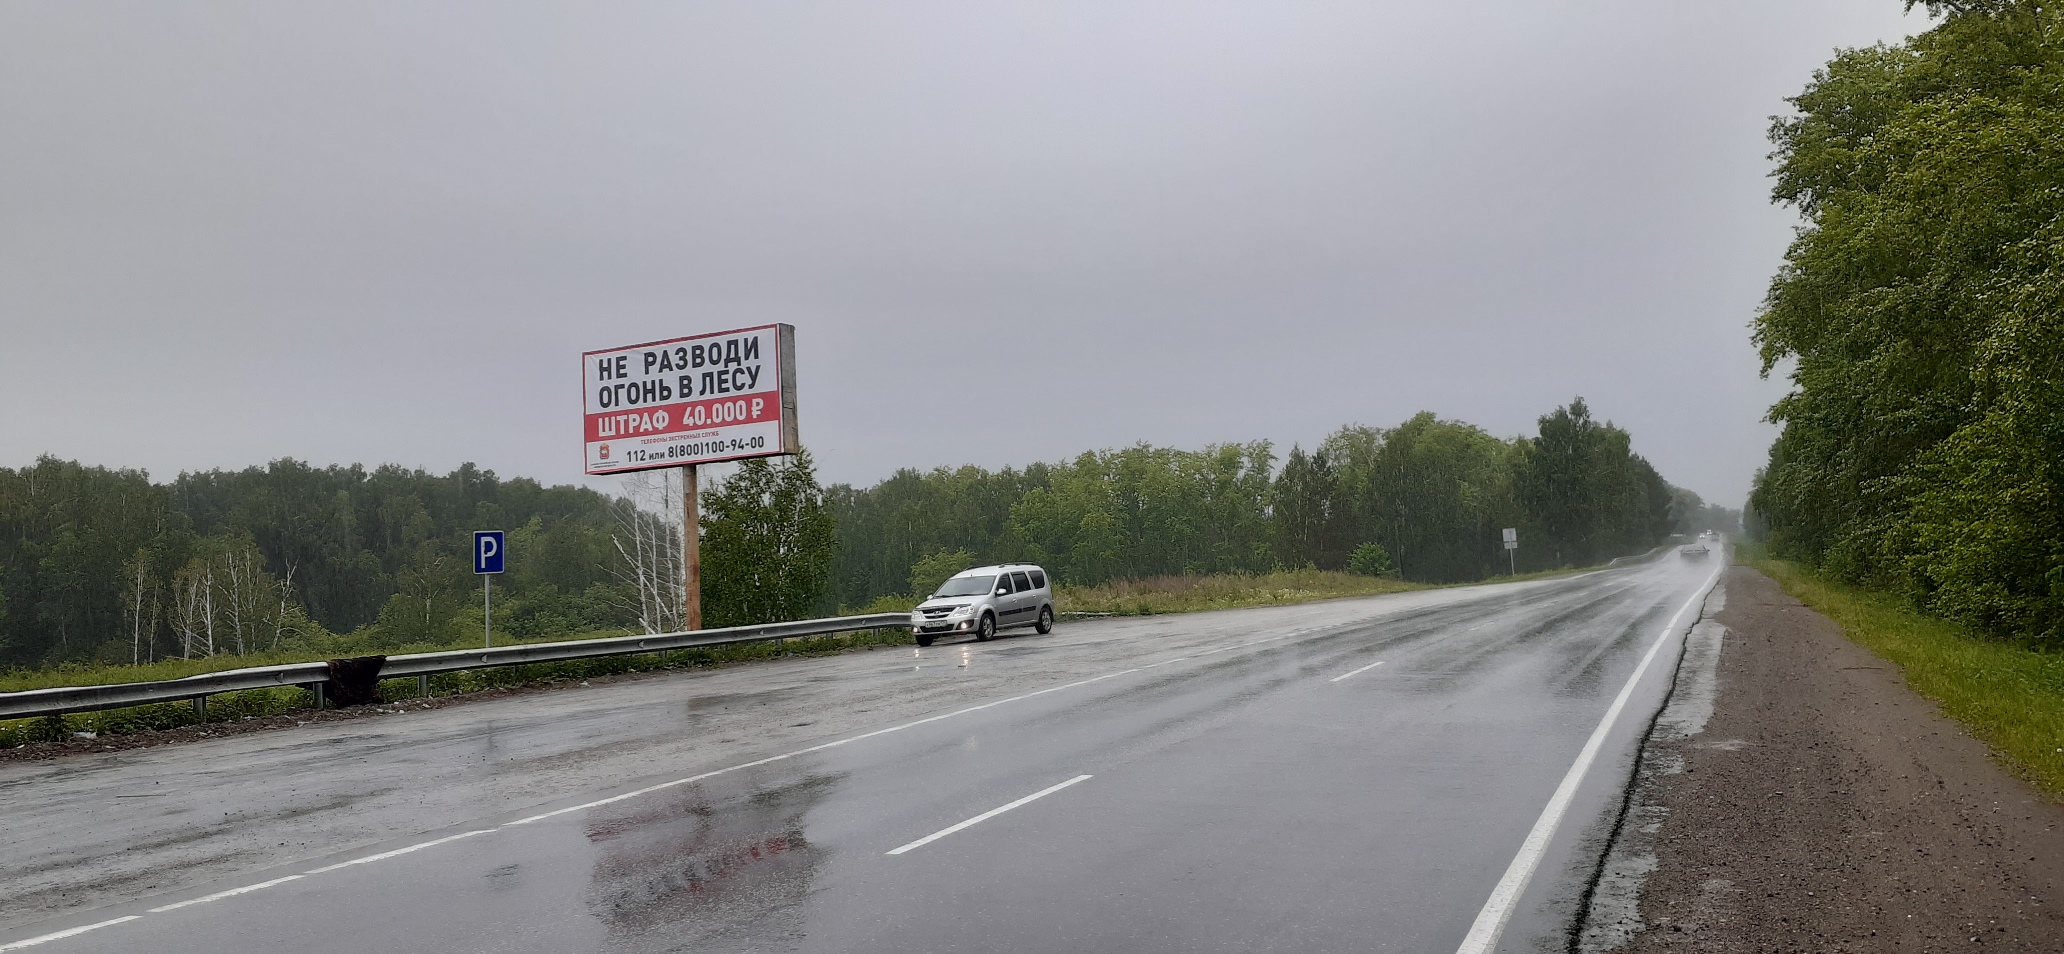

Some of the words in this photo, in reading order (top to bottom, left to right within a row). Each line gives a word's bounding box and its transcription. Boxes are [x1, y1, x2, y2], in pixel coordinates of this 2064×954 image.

[598, 355, 628, 381] НЕ
[643, 336, 760, 375] РАЗВОДИ
[598, 381, 673, 409] ОГОНЬ
[678, 375, 693, 399] В
[699, 364, 761, 396] ЛЕСУ
[598, 409, 670, 438] ШТРАФ
[682, 400, 747, 427] 40.000
[626, 449, 646, 463] 112
[648, 451, 666, 461] или
[668, 436, 765, 458] 8(800)100-94-00
[480, 536, 497, 569] P
